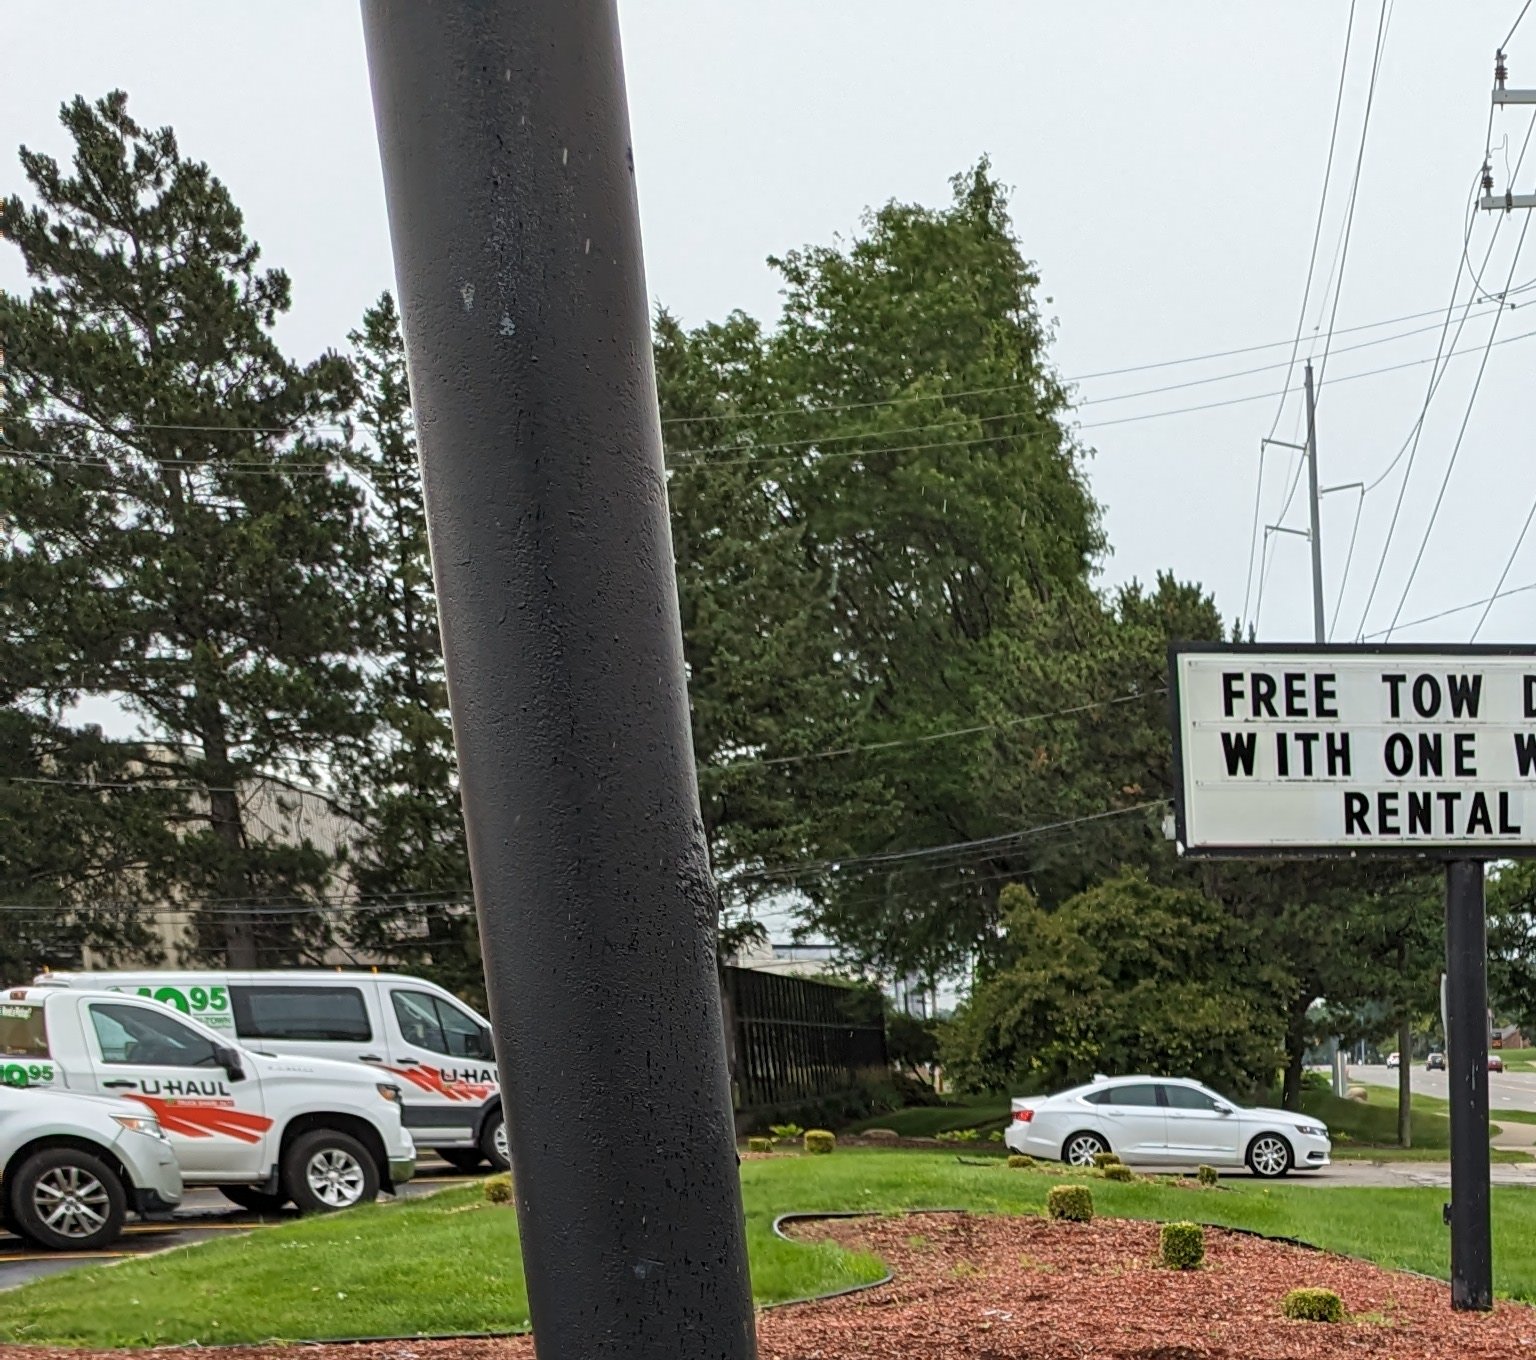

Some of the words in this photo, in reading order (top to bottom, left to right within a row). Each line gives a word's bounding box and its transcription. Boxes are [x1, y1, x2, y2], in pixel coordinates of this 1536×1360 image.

[1222, 672, 1338, 718] FREE
[1382, 673, 1483, 719] TOW
[1221, 732, 1350, 776] WITH
[1384, 732, 1477, 777] ONE
[1344, 791, 1521, 835] RENTAL
[141, 1080, 231, 1096] U-HAUL
[440, 1068, 499, 1083] U-HA
